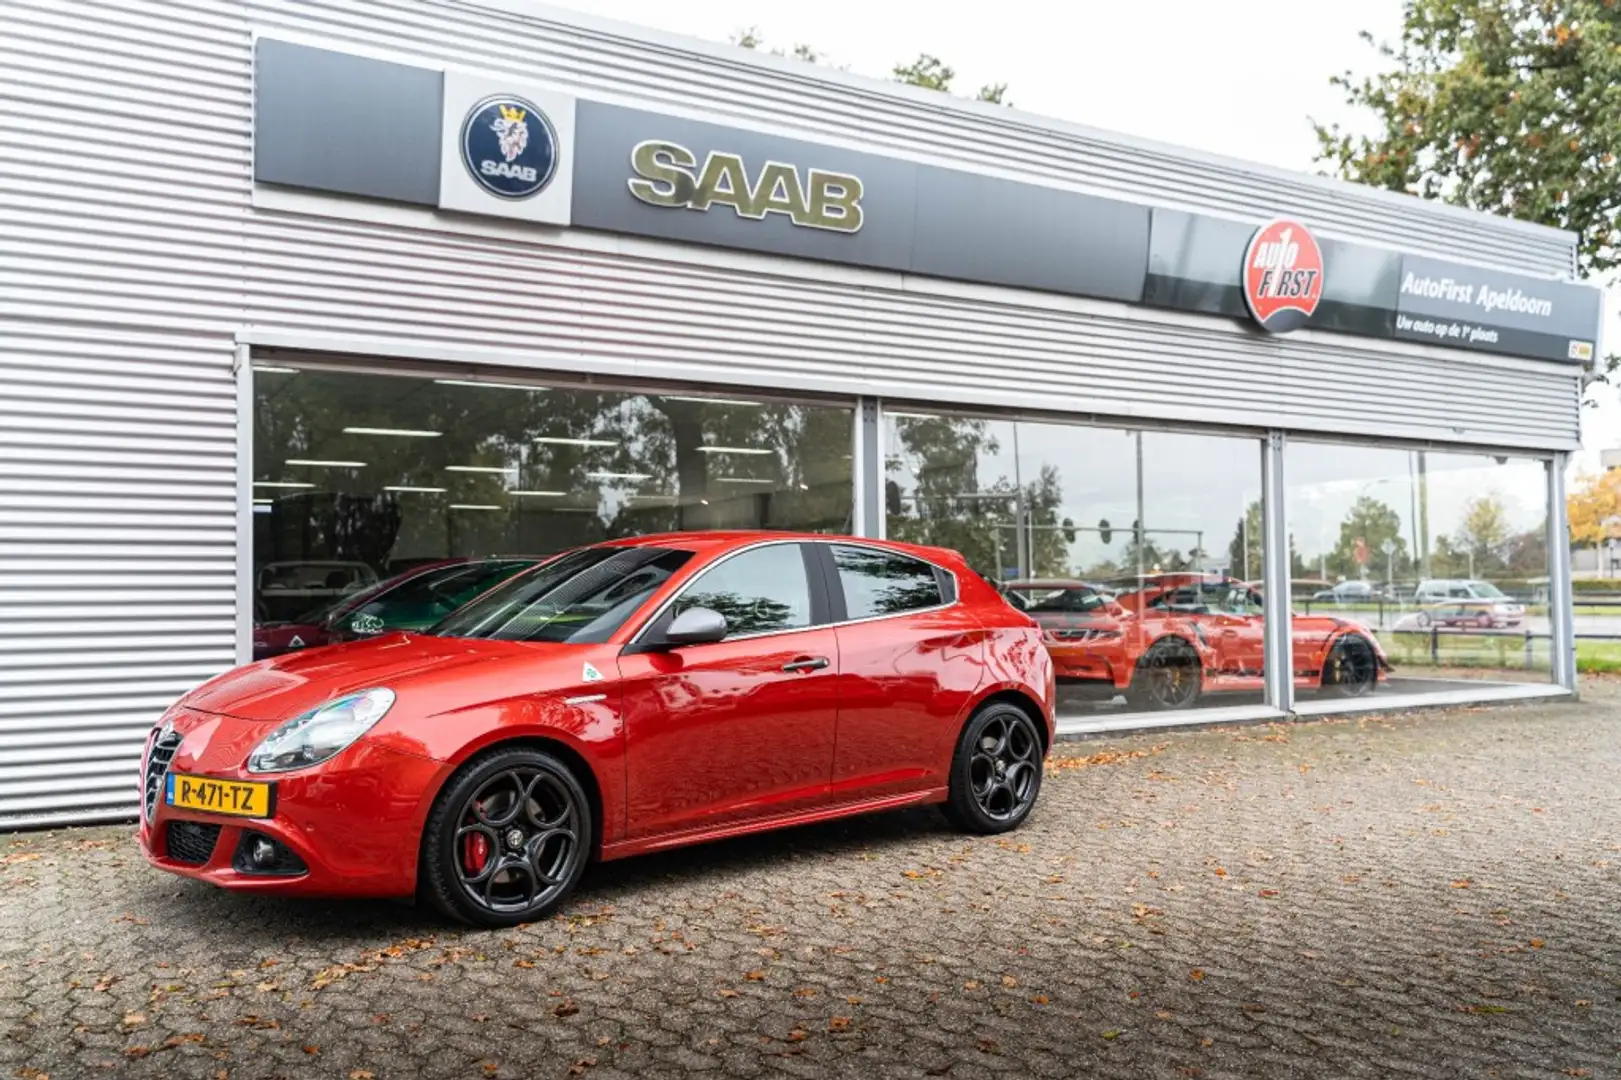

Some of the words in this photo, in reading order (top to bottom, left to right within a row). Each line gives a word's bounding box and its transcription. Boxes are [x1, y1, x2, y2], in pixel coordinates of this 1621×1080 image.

[481, 159, 537, 182] SAAB
[626, 138, 864, 234] SAAB
[1400, 271, 1474, 304] AutoFirst
[1475, 284, 1553, 317] Apeldoorn
[1396, 314, 1414, 330] Uw
[1413, 319, 1435, 334] auto
[1434, 323, 1448, 339] op
[1448, 322, 1461, 338] de
[1469, 326, 1499, 343] plaats
[181, 780, 254, 810] R-471-TZ
